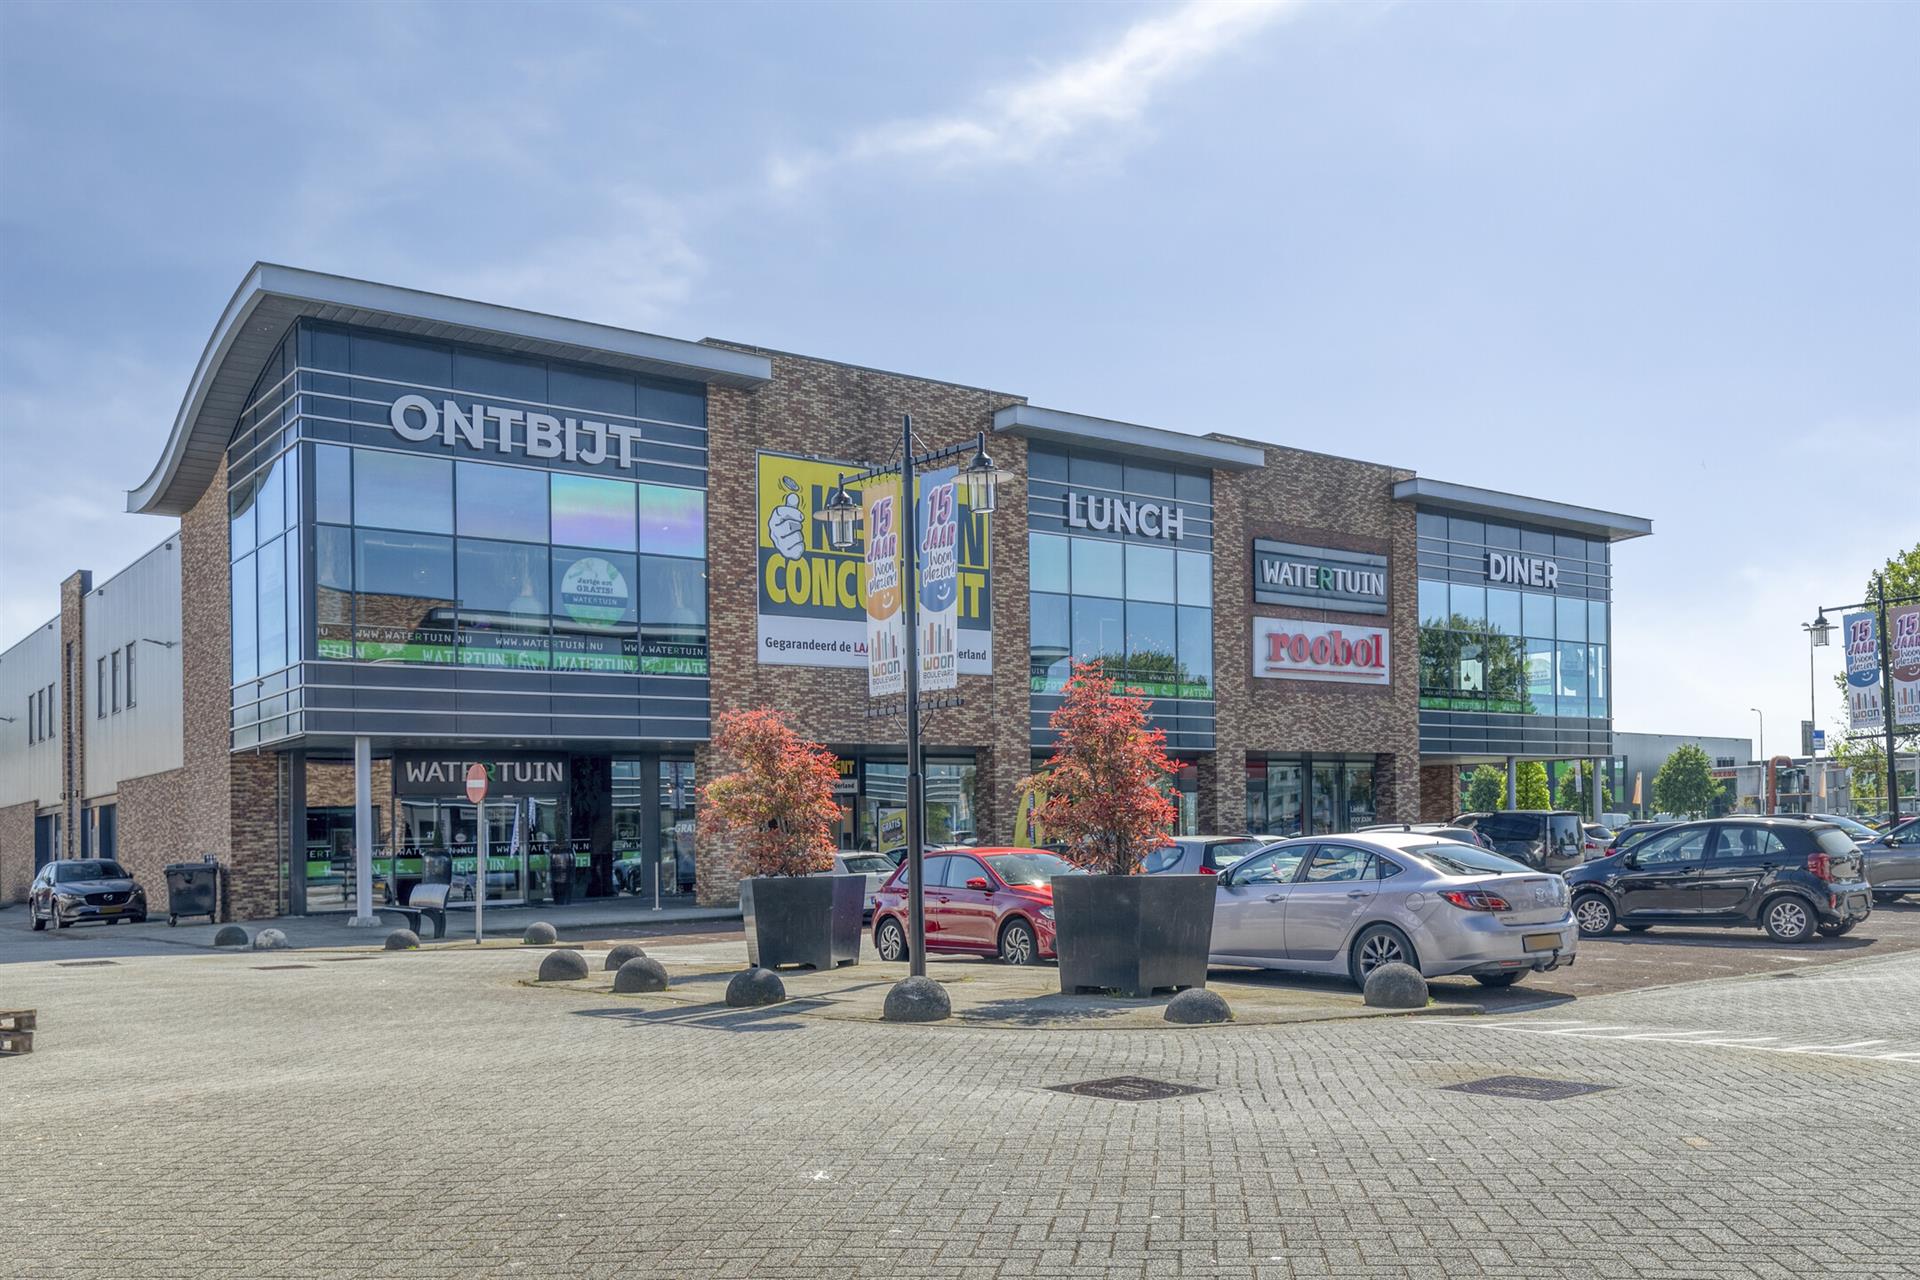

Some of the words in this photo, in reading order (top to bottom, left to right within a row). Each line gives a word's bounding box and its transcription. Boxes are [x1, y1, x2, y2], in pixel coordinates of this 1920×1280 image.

[390, 394, 641, 468] ONTBIJT
[870, 496, 893, 538] 15
[928, 484, 953, 527] 15
[1068, 492, 1184, 540] LUNCH
[868, 534, 897, 562] JAAR
[923, 523, 956, 551] JAAR
[1262, 559, 1384, 596] WATERTUIN
[1488, 553, 1558, 588] DINER
[1850, 619, 1872, 642] 15
[1897, 613, 1919, 637] 15
[765, 637, 837, 651] Gegarandeerd
[839, 641, 851, 653] de
[1266, 630, 1386, 668] roobol
[1847, 640, 1876, 656] JAAR
